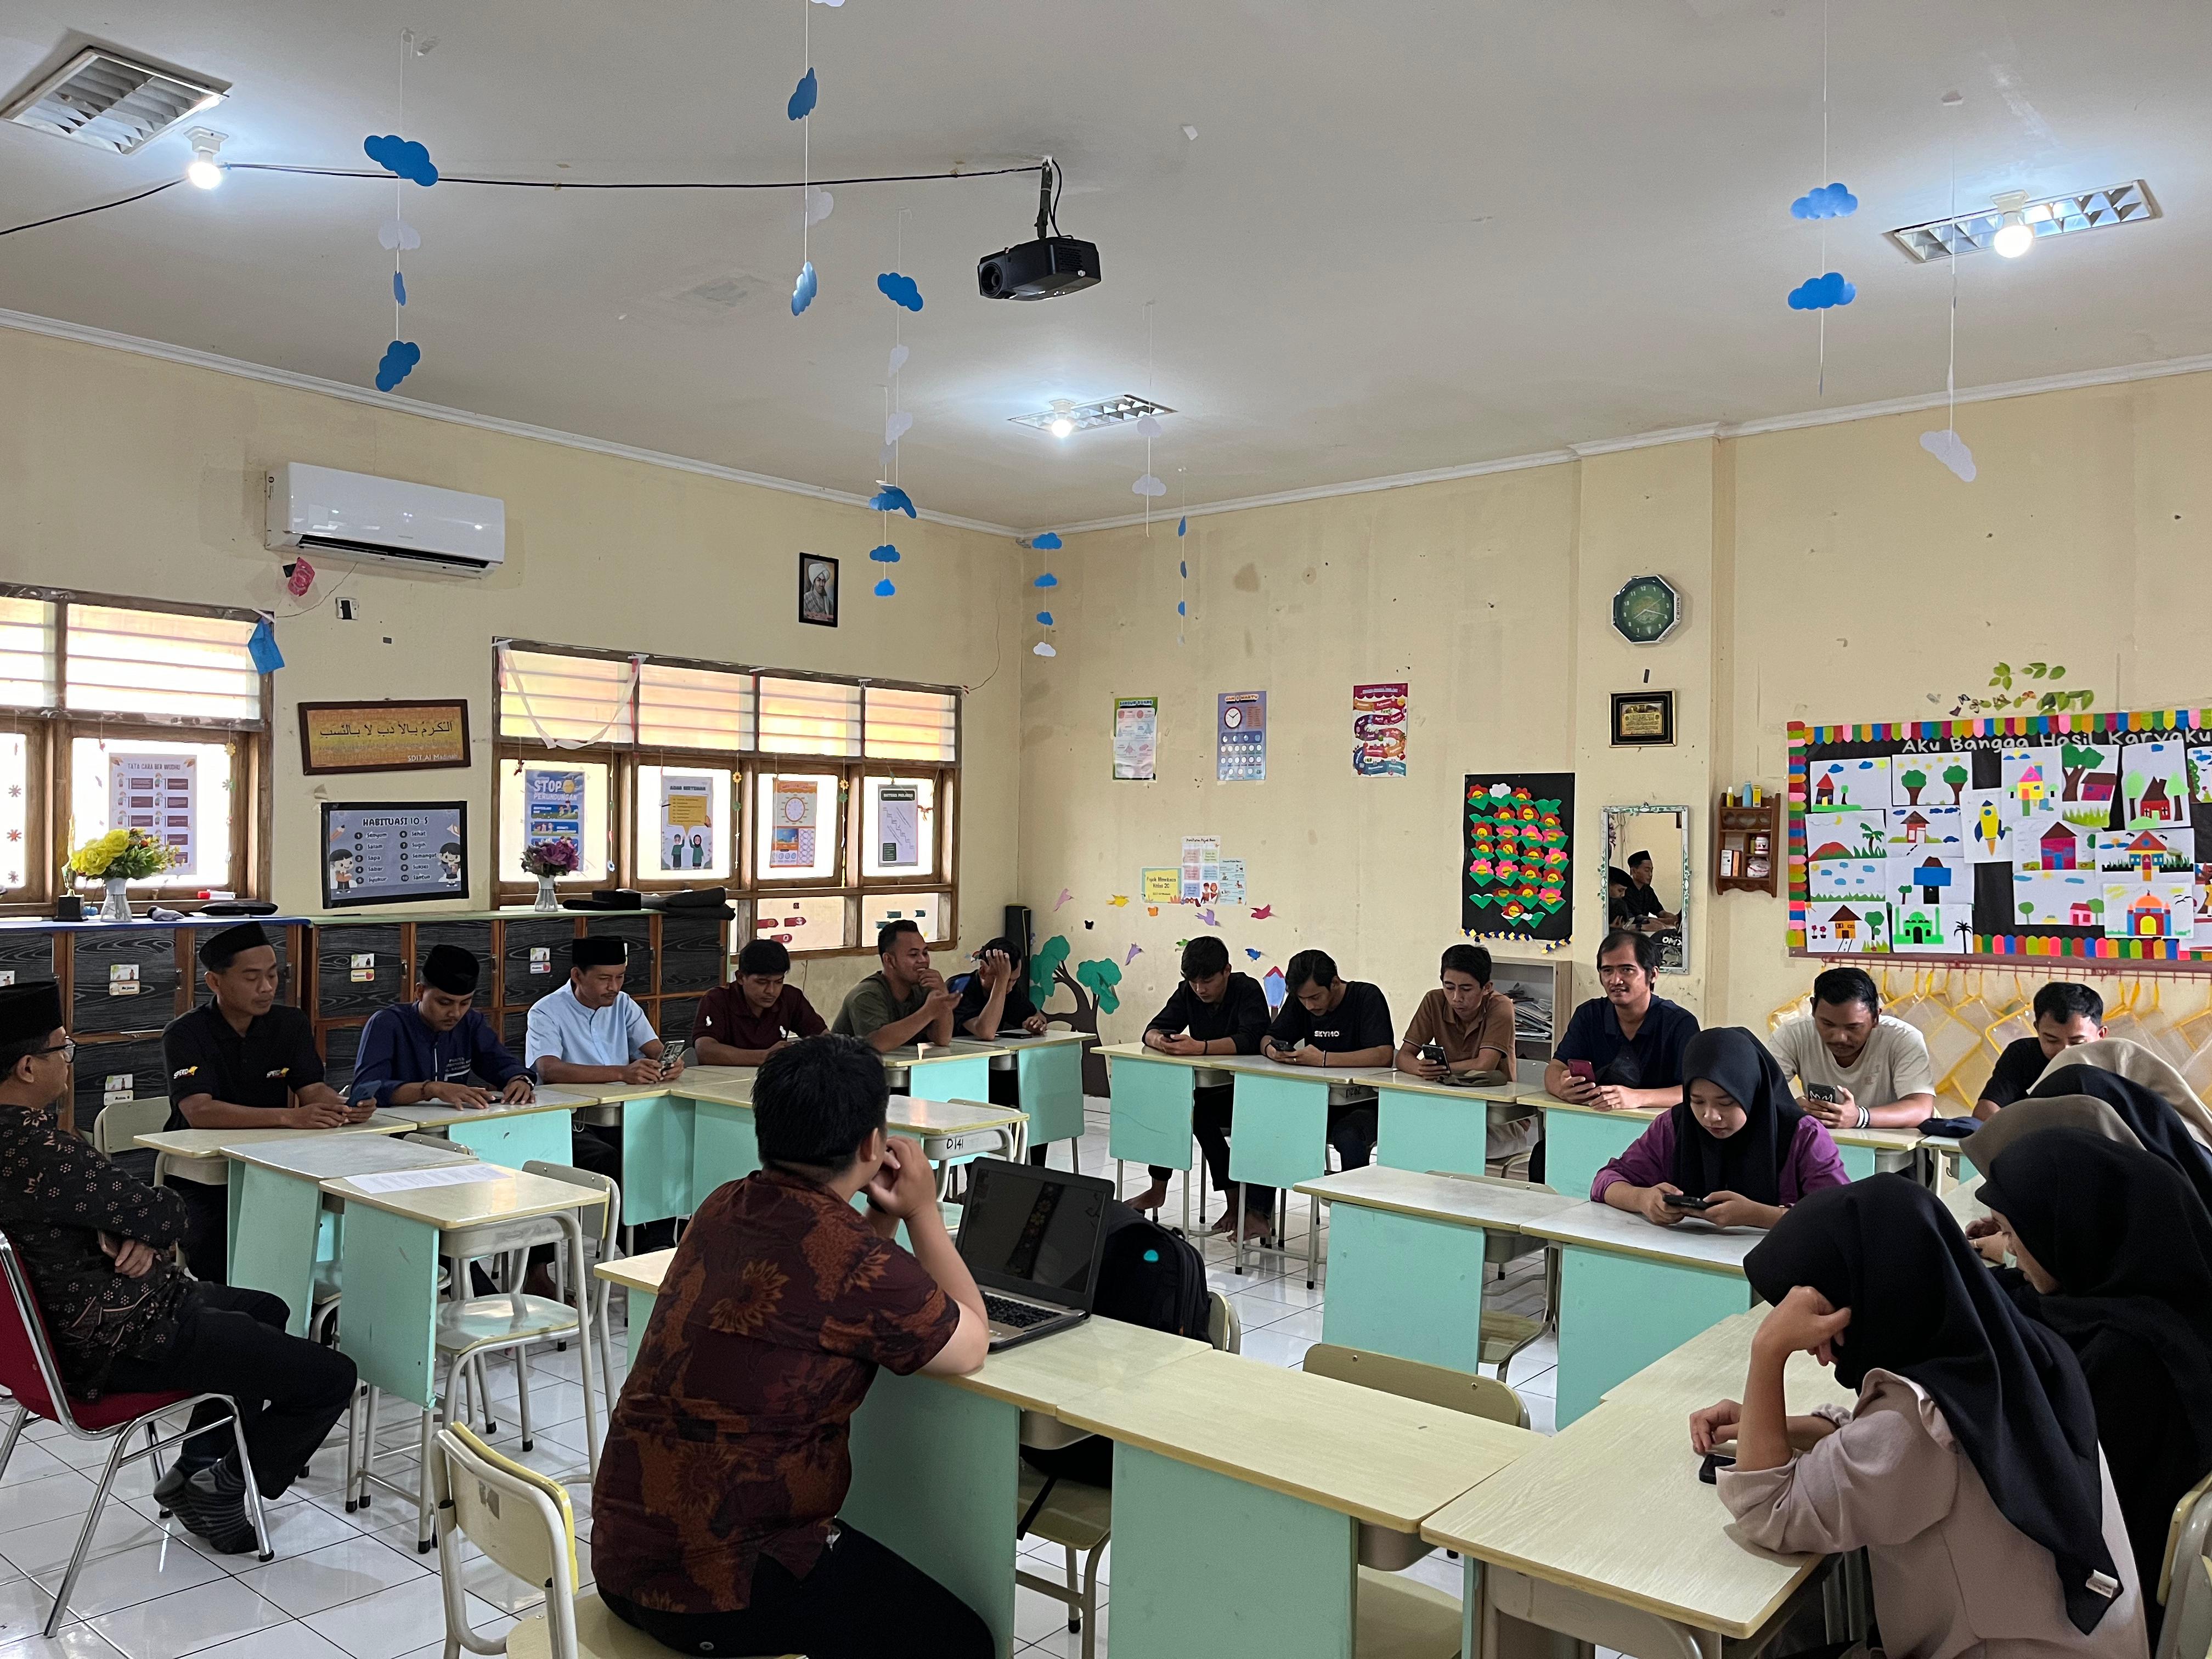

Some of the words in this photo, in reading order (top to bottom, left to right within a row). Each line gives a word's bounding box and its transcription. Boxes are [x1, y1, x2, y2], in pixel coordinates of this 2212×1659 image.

[1902, 738, 1940, 753] Aku
[534, 780, 562, 793] STOP
[363, 817, 408, 826] HABITUASI
[410, 817, 420, 825] 10
